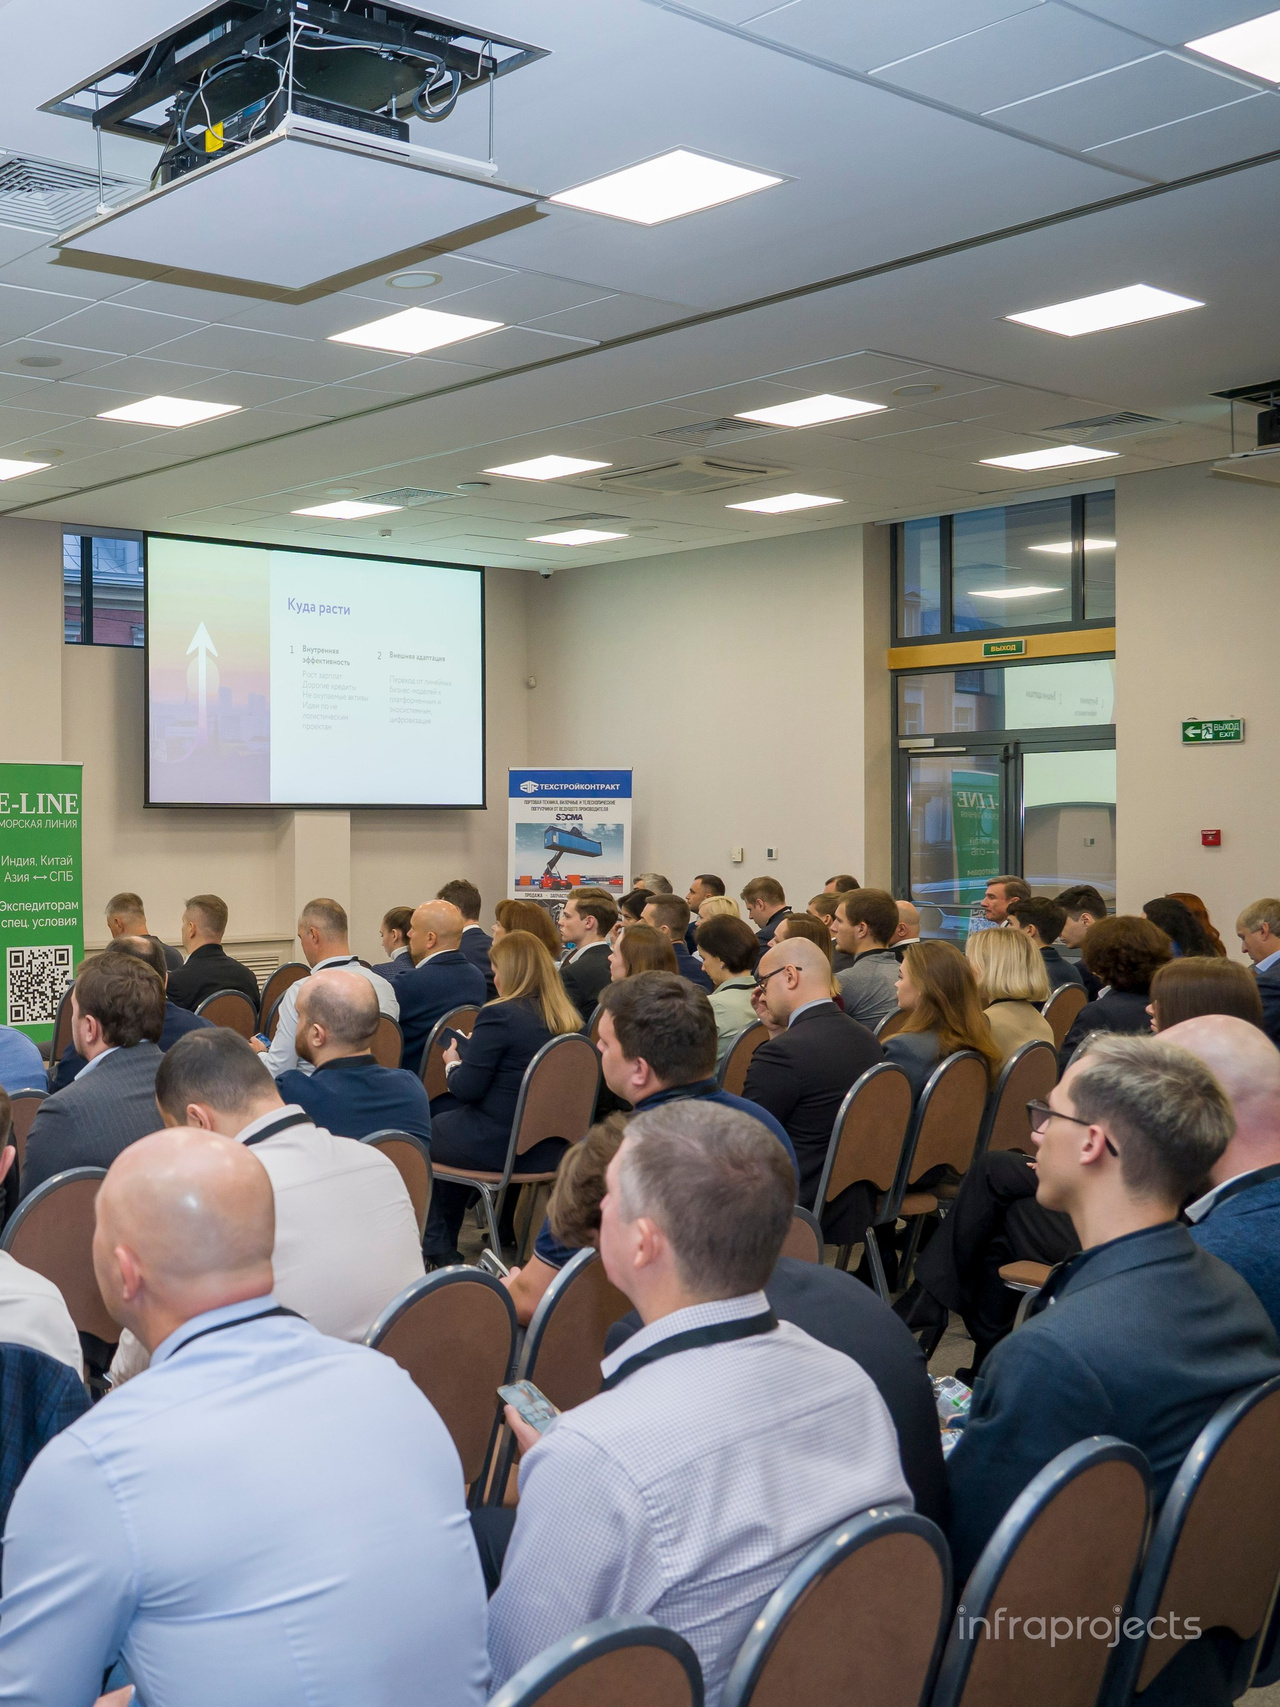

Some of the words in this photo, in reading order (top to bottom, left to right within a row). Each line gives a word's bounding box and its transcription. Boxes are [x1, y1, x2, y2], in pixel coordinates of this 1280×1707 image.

[287, 597, 316, 615] Куда
[319, 604, 351, 616] расти
[289, 645, 294, 654] 1
[302, 644, 339, 655] Внутренняя
[990, 644, 1016, 652] ВЫХОД
[377, 651, 382, 660] 2
[389, 650, 415, 660] Внешняя
[302, 656, 351, 666] эффективность
[1213, 722, 1239, 731] ВЫХОД
[540, 782, 621, 791] ТЕХСТРОЙКОНТРАКТ
[44, 819, 78, 828] ЛИНИЯ
[1, 855, 38, 867] Индия,
[40, 854, 73, 866] Китай
[4, 871, 29, 882] Азия
[49, 870, 74, 882] СПБ
[1, 918, 30, 928] спец.
[32, 917, 77, 930] условия
